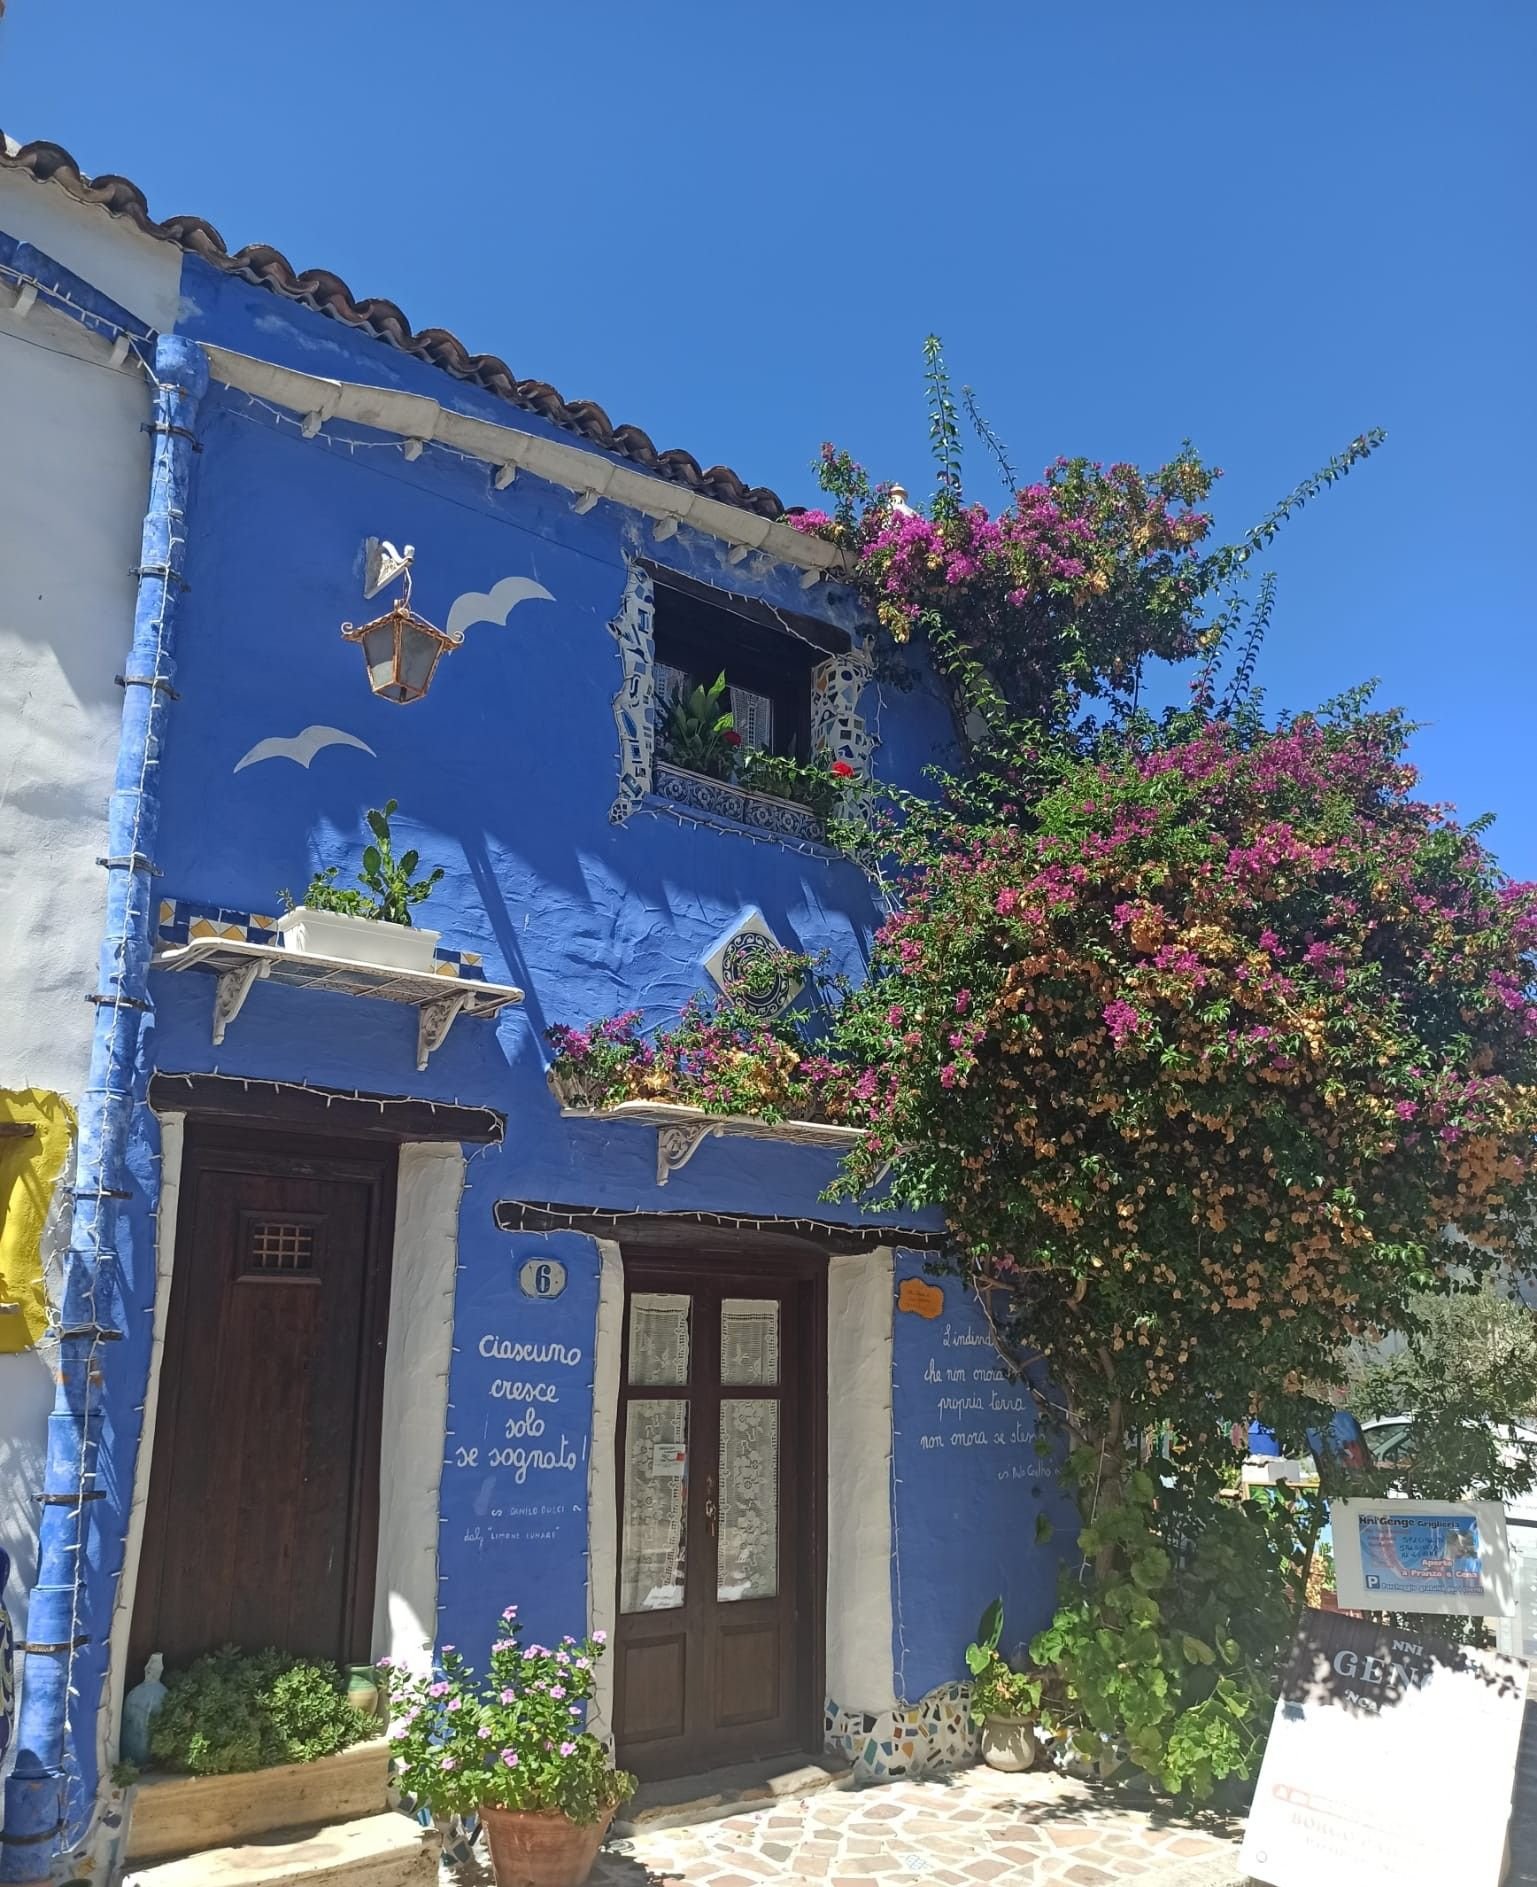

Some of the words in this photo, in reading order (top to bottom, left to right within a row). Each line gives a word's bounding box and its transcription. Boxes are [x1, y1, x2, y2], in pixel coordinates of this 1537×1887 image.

[535, 1264, 550, 1294] 6
[479, 1334, 581, 1366] Ciascuno
[924, 1357, 943, 1383] che
[946, 1369, 966, 1382] non
[490, 1378, 560, 1403] cresce
[938, 1392, 984, 1421] propria
[989, 1390, 1026, 1411] terra
[505, 1407, 545, 1438] solo
[920, 1434, 944, 1449] non
[951, 1431, 988, 1445] onora
[993, 1432, 1006, 1445] se
[456, 1446, 479, 1468] se
[488, 1433, 577, 1484] sognato
[1380, 1517, 1415, 1529] Genge
[1367, 1576, 1378, 1588] P
[1411, 1569, 1442, 1577] Pranzo
[1391, 1639, 1424, 1657] NNI
